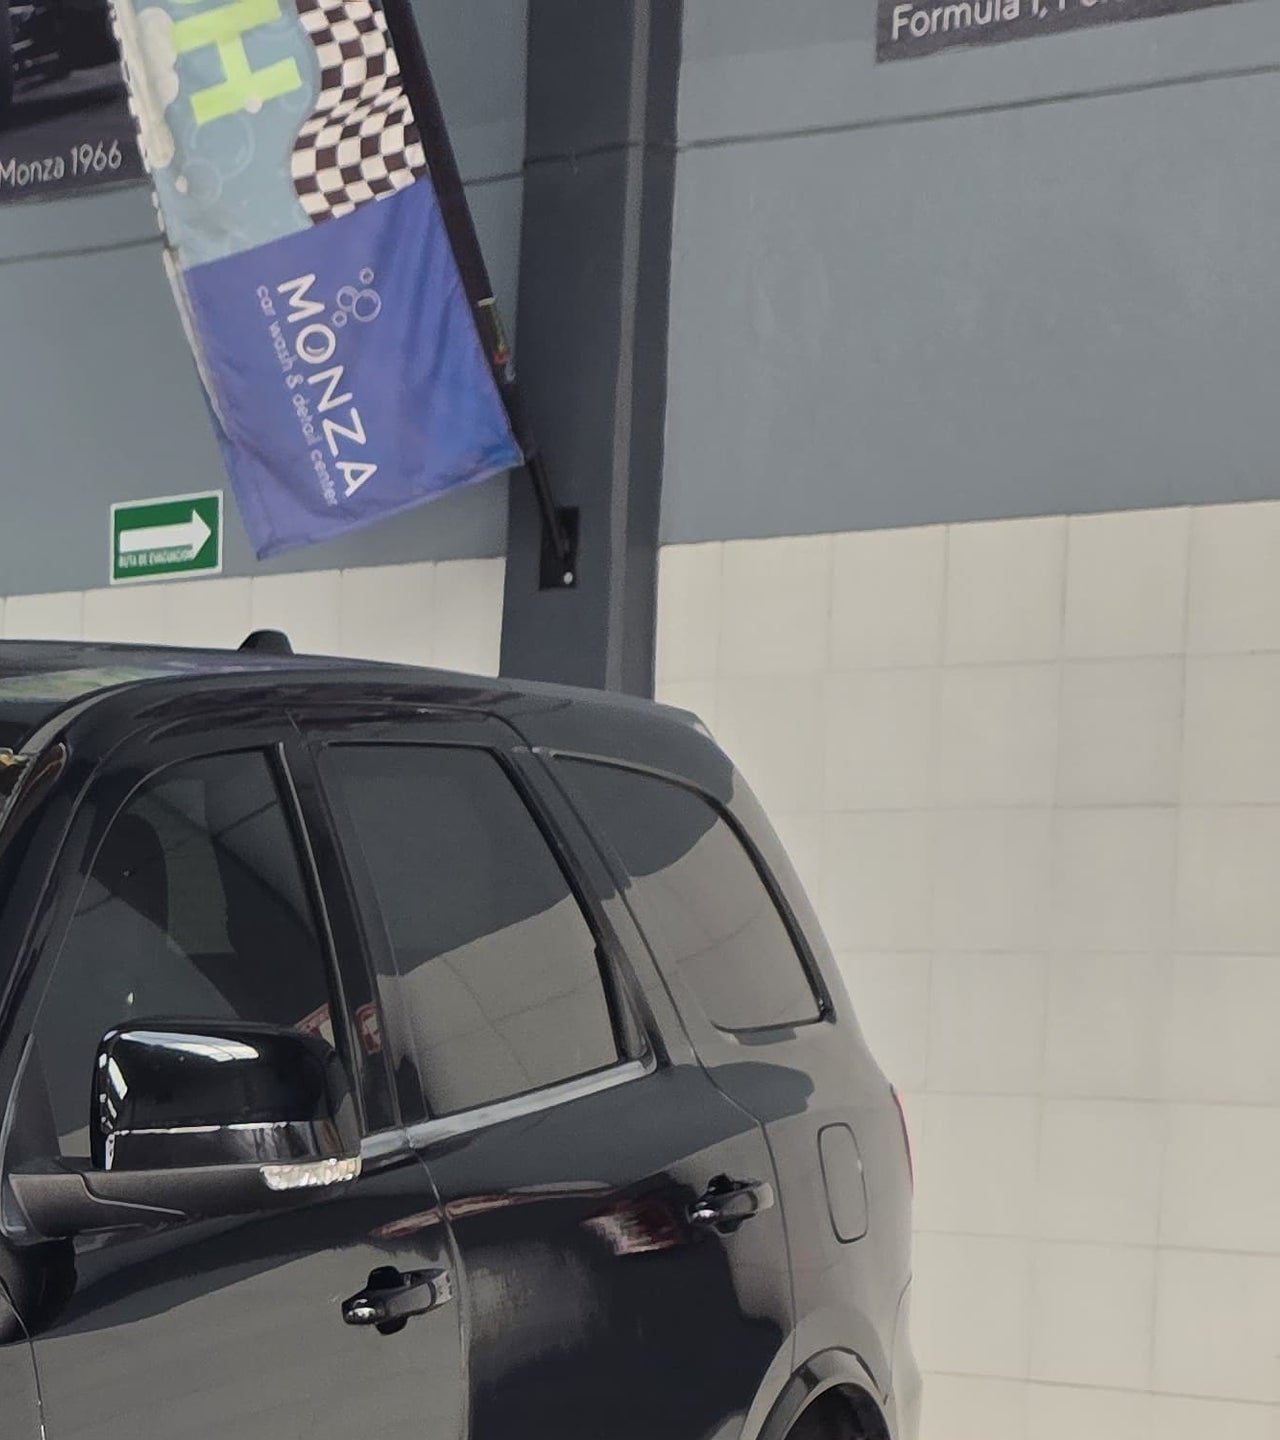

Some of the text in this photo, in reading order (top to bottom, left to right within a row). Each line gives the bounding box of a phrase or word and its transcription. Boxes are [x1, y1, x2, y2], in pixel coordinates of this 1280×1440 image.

[892, 0, 1020, 40] Formula
[70, 139, 122, 176] 1966
[256, 285, 277, 316] car
[269, 320, 299, 373] wash
[292, 393, 323, 446] detail
[311, 449, 338, 507] center
[277, 273, 378, 498] MONZA
